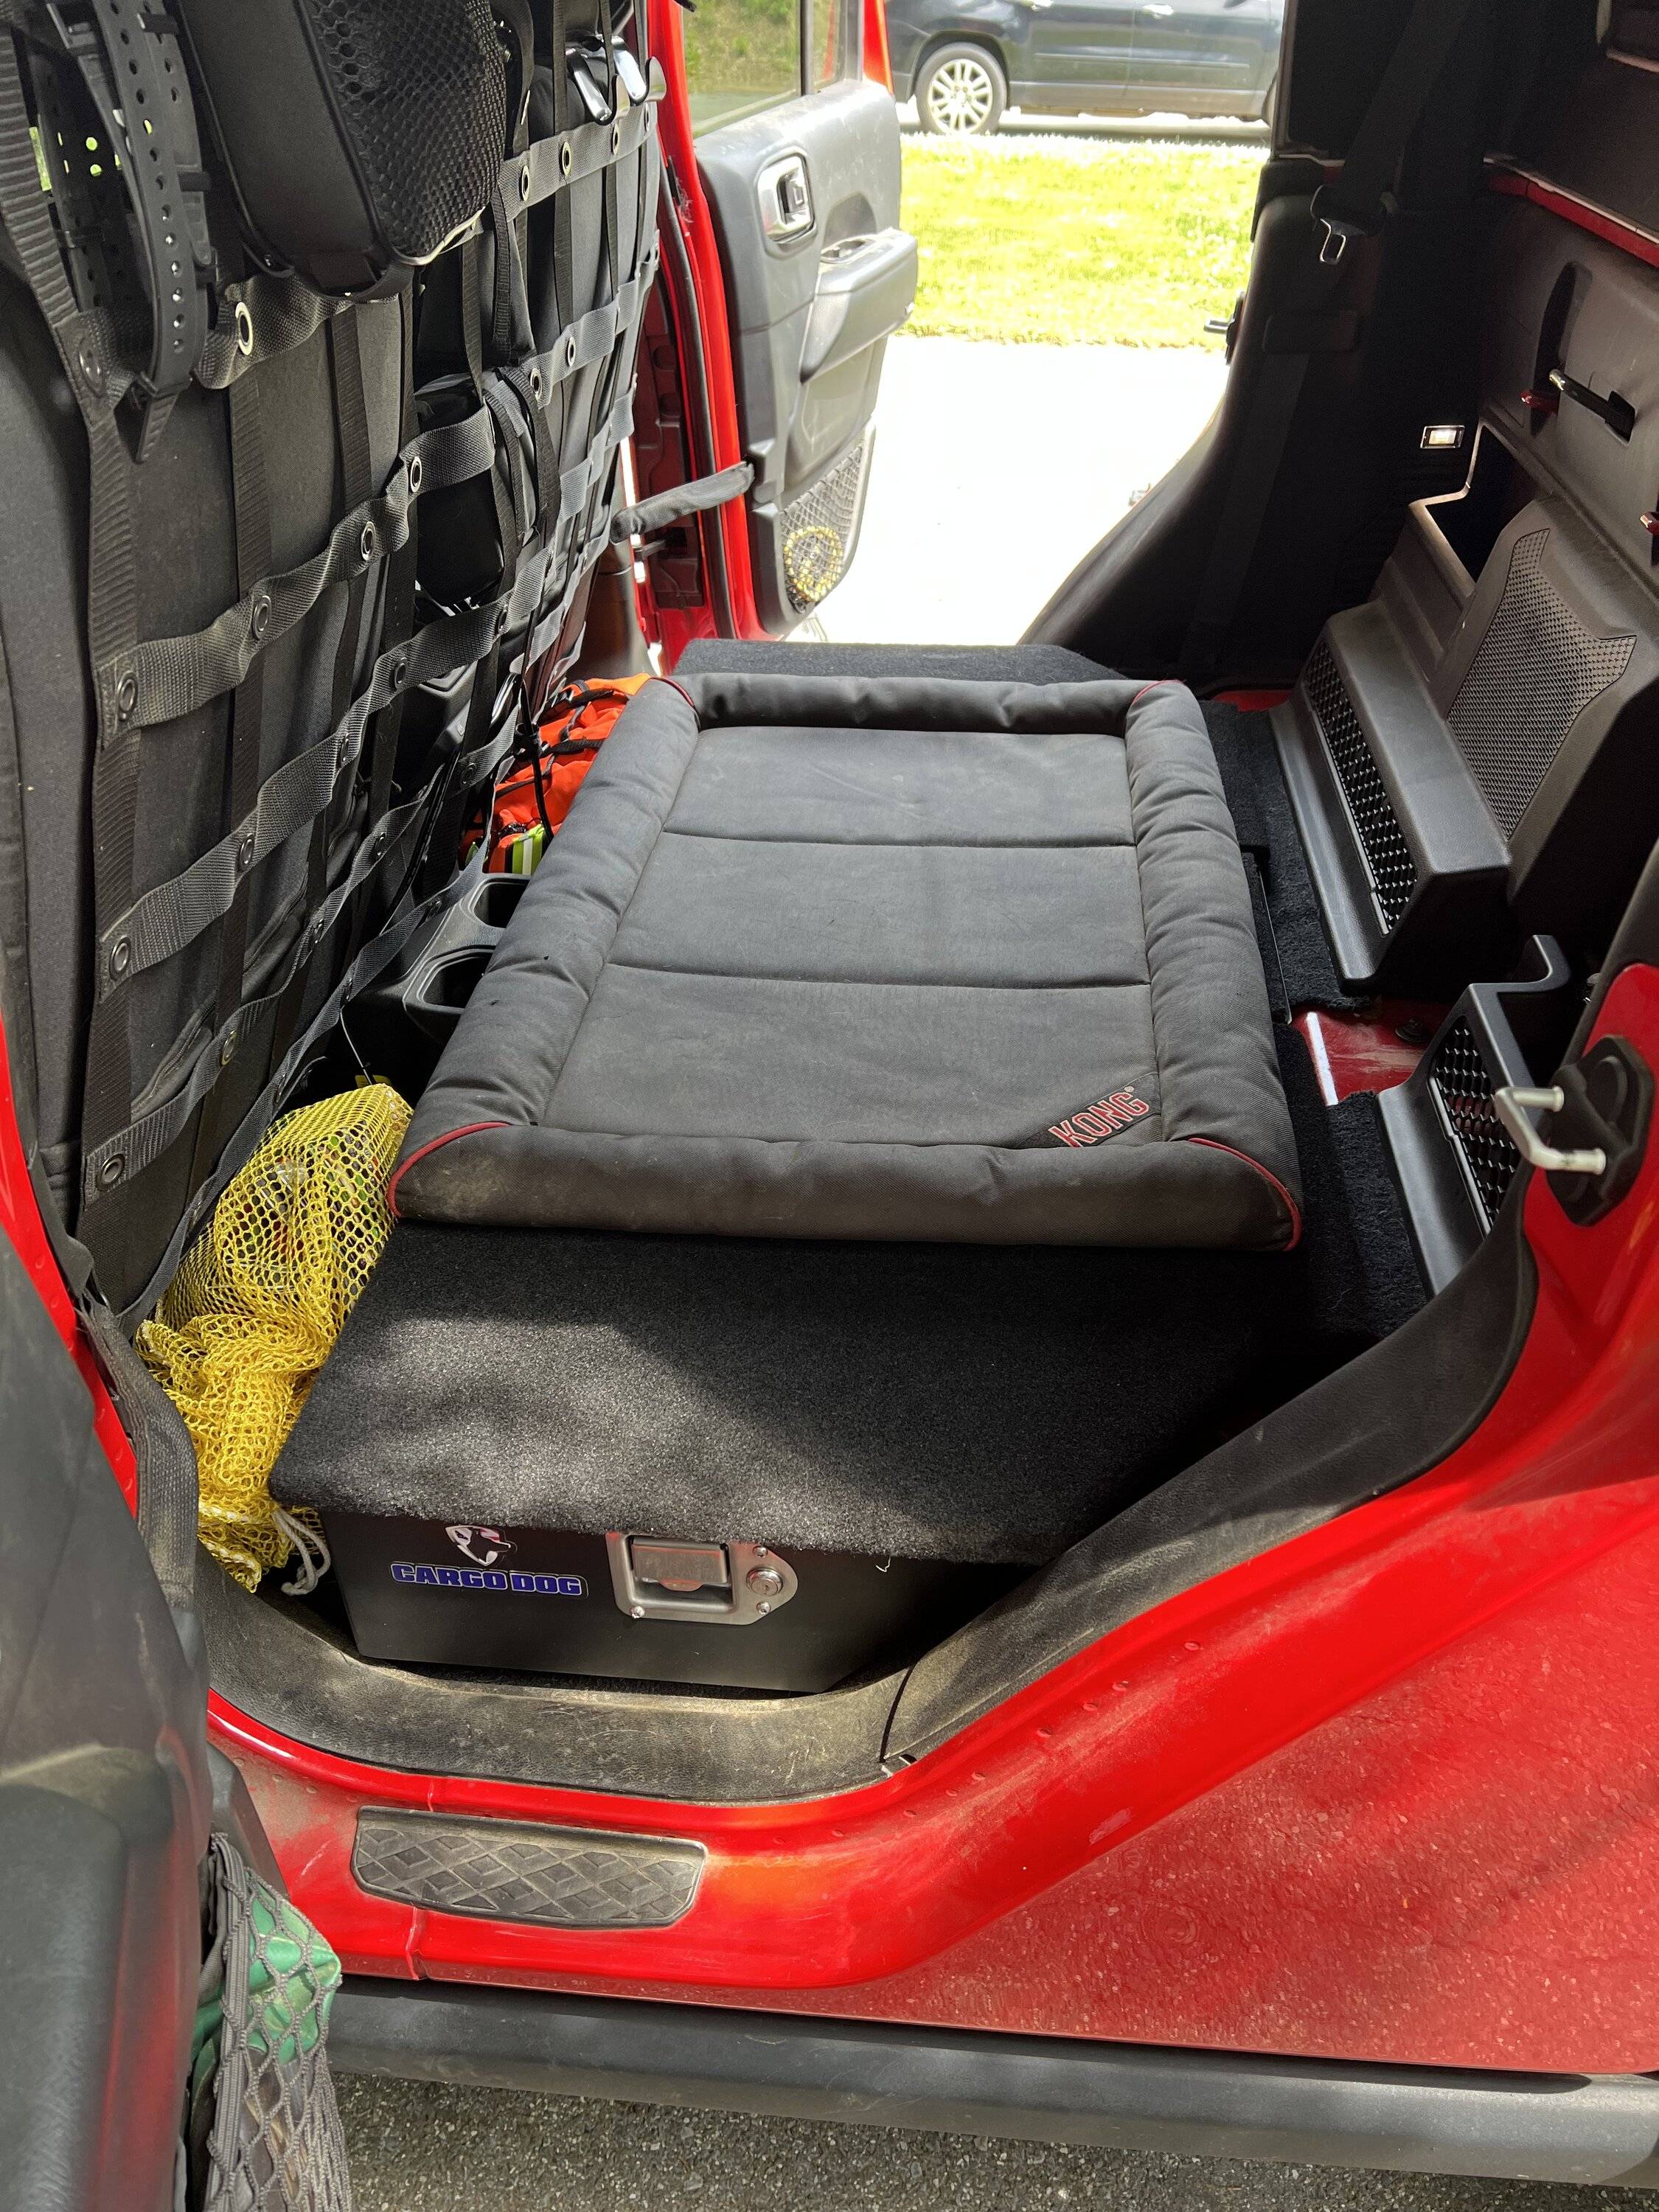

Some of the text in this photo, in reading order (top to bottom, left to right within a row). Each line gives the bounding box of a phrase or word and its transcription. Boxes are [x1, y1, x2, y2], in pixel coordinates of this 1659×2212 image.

[1048, 1091, 1150, 1148] KONG
[390, 1562, 582, 1596] CARGO DOG
